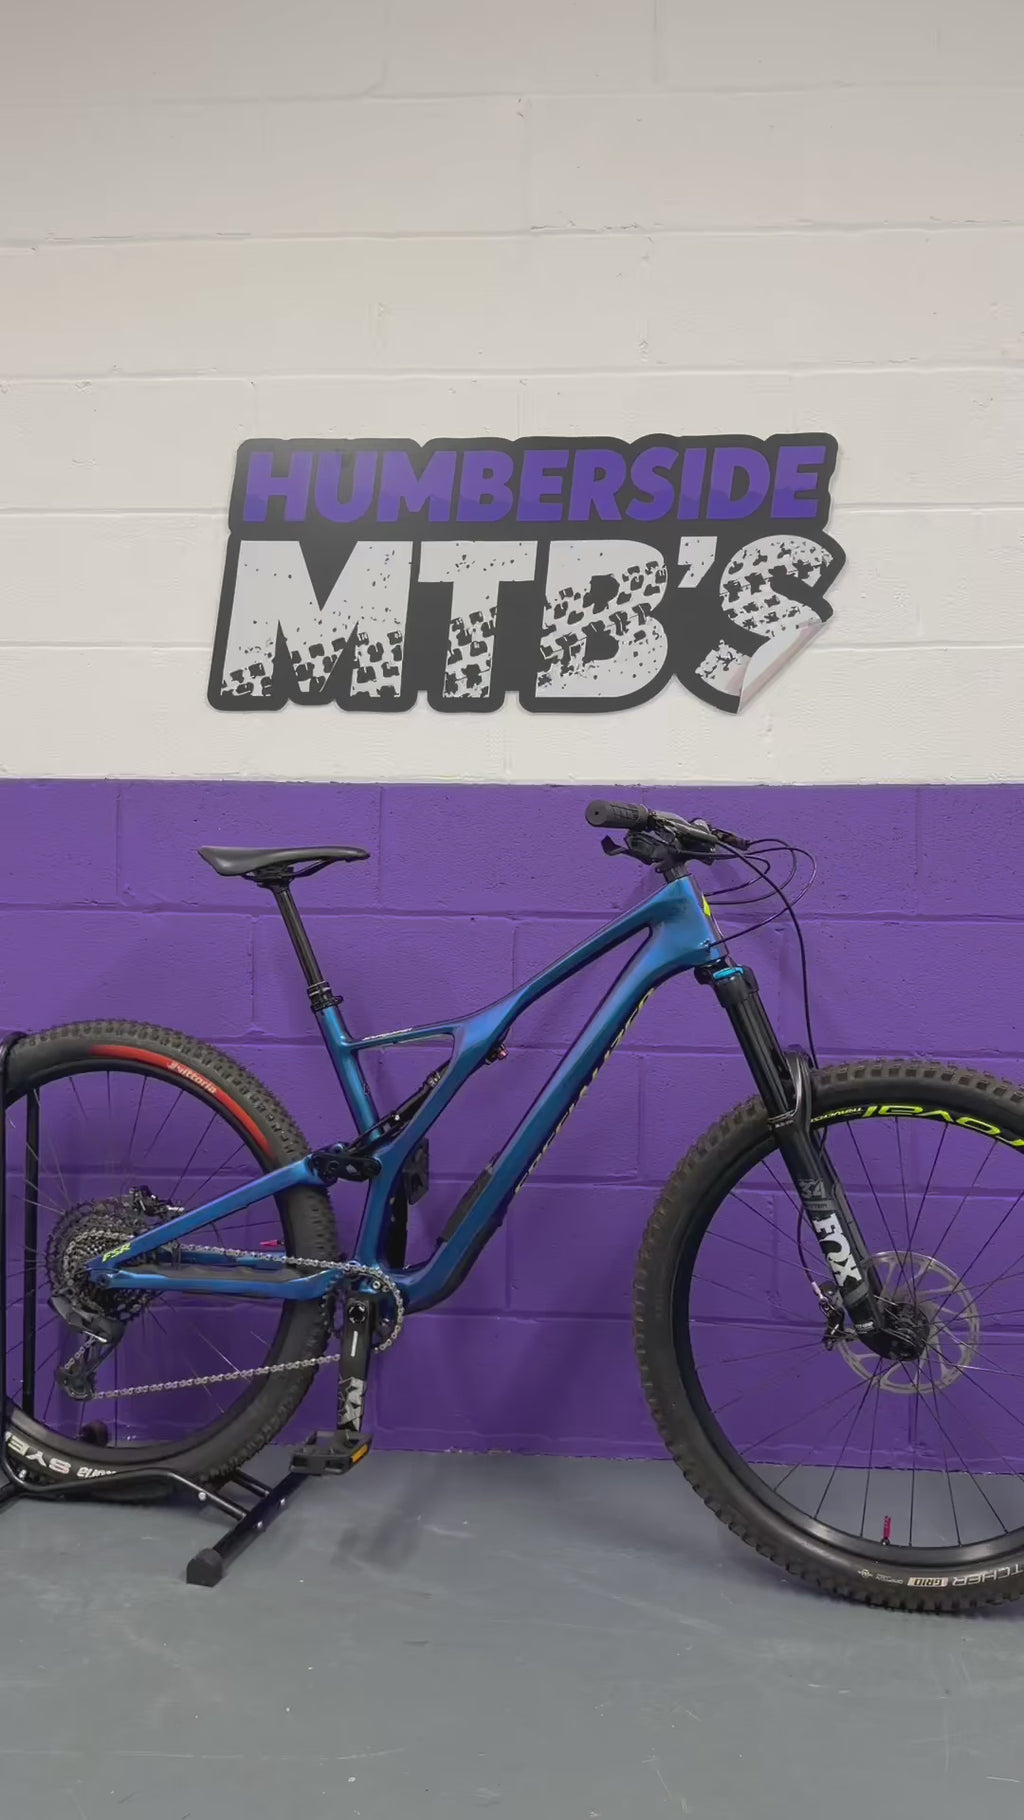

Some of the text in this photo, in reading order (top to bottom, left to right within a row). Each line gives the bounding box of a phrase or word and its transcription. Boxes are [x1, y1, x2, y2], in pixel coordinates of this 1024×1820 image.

[242, 445, 828, 523] HUMBERSIDE
[219, 534, 835, 700] MTB'S
[812, 1213, 862, 1287] FOX
[5, 1431, 71, 1474] SYE
